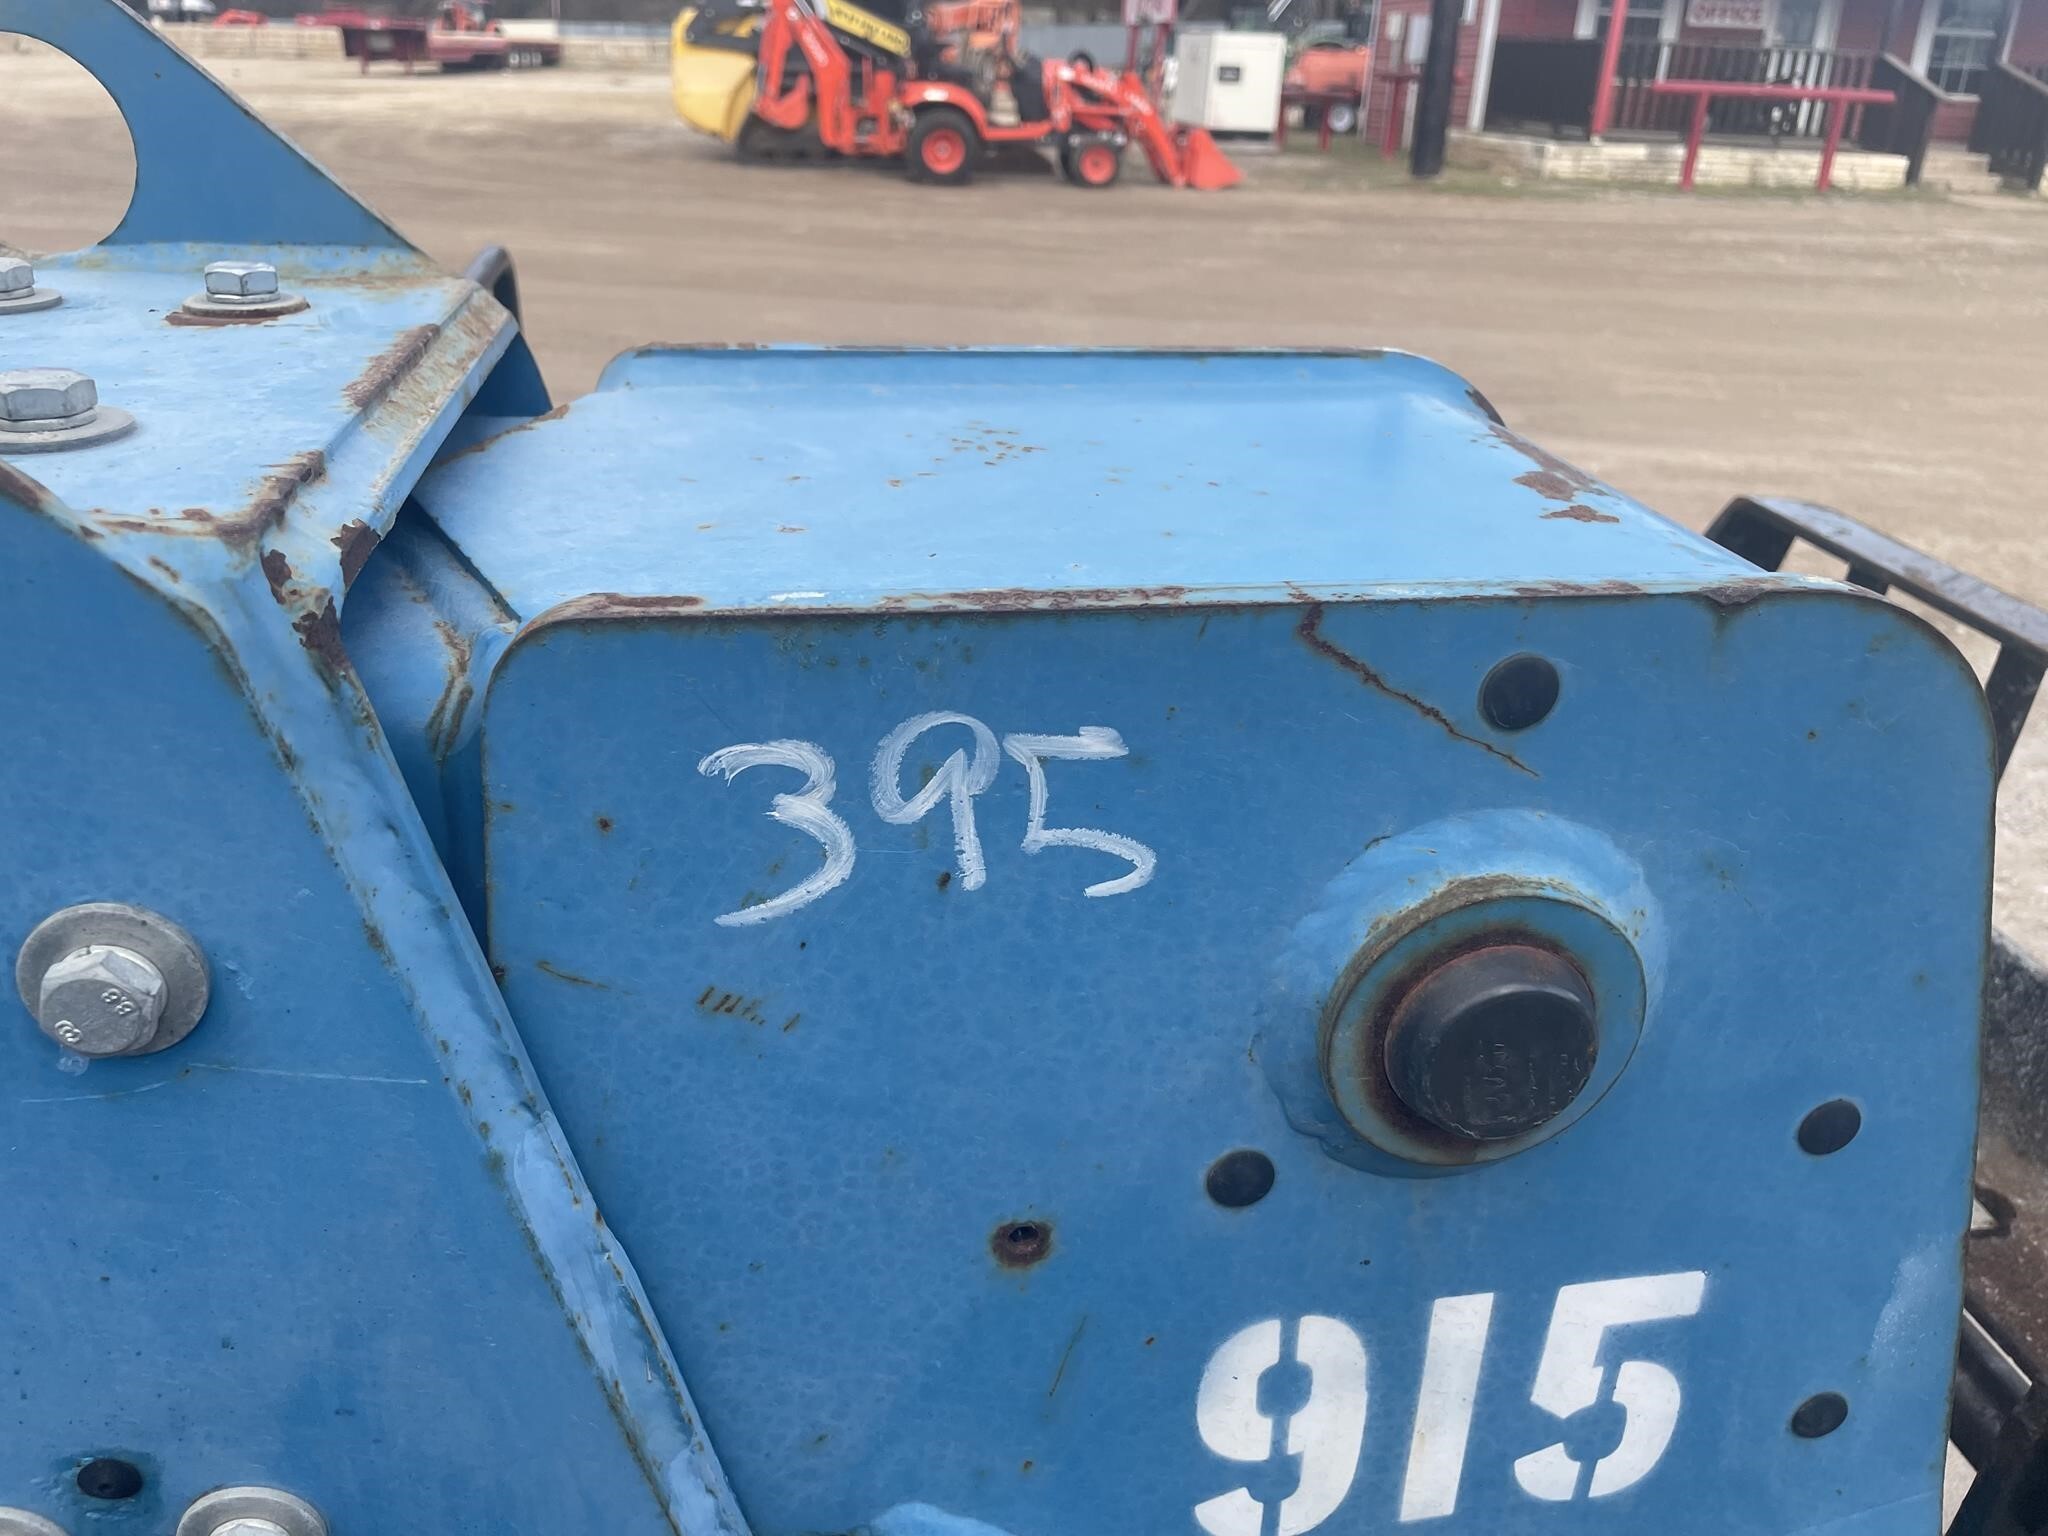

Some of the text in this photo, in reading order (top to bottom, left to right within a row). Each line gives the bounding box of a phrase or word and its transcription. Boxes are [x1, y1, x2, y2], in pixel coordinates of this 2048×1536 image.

[1694, 4, 1762, 24] OFFICE
[698, 711, 1157, 927] 395
[1195, 1271, 1707, 1536] 915
